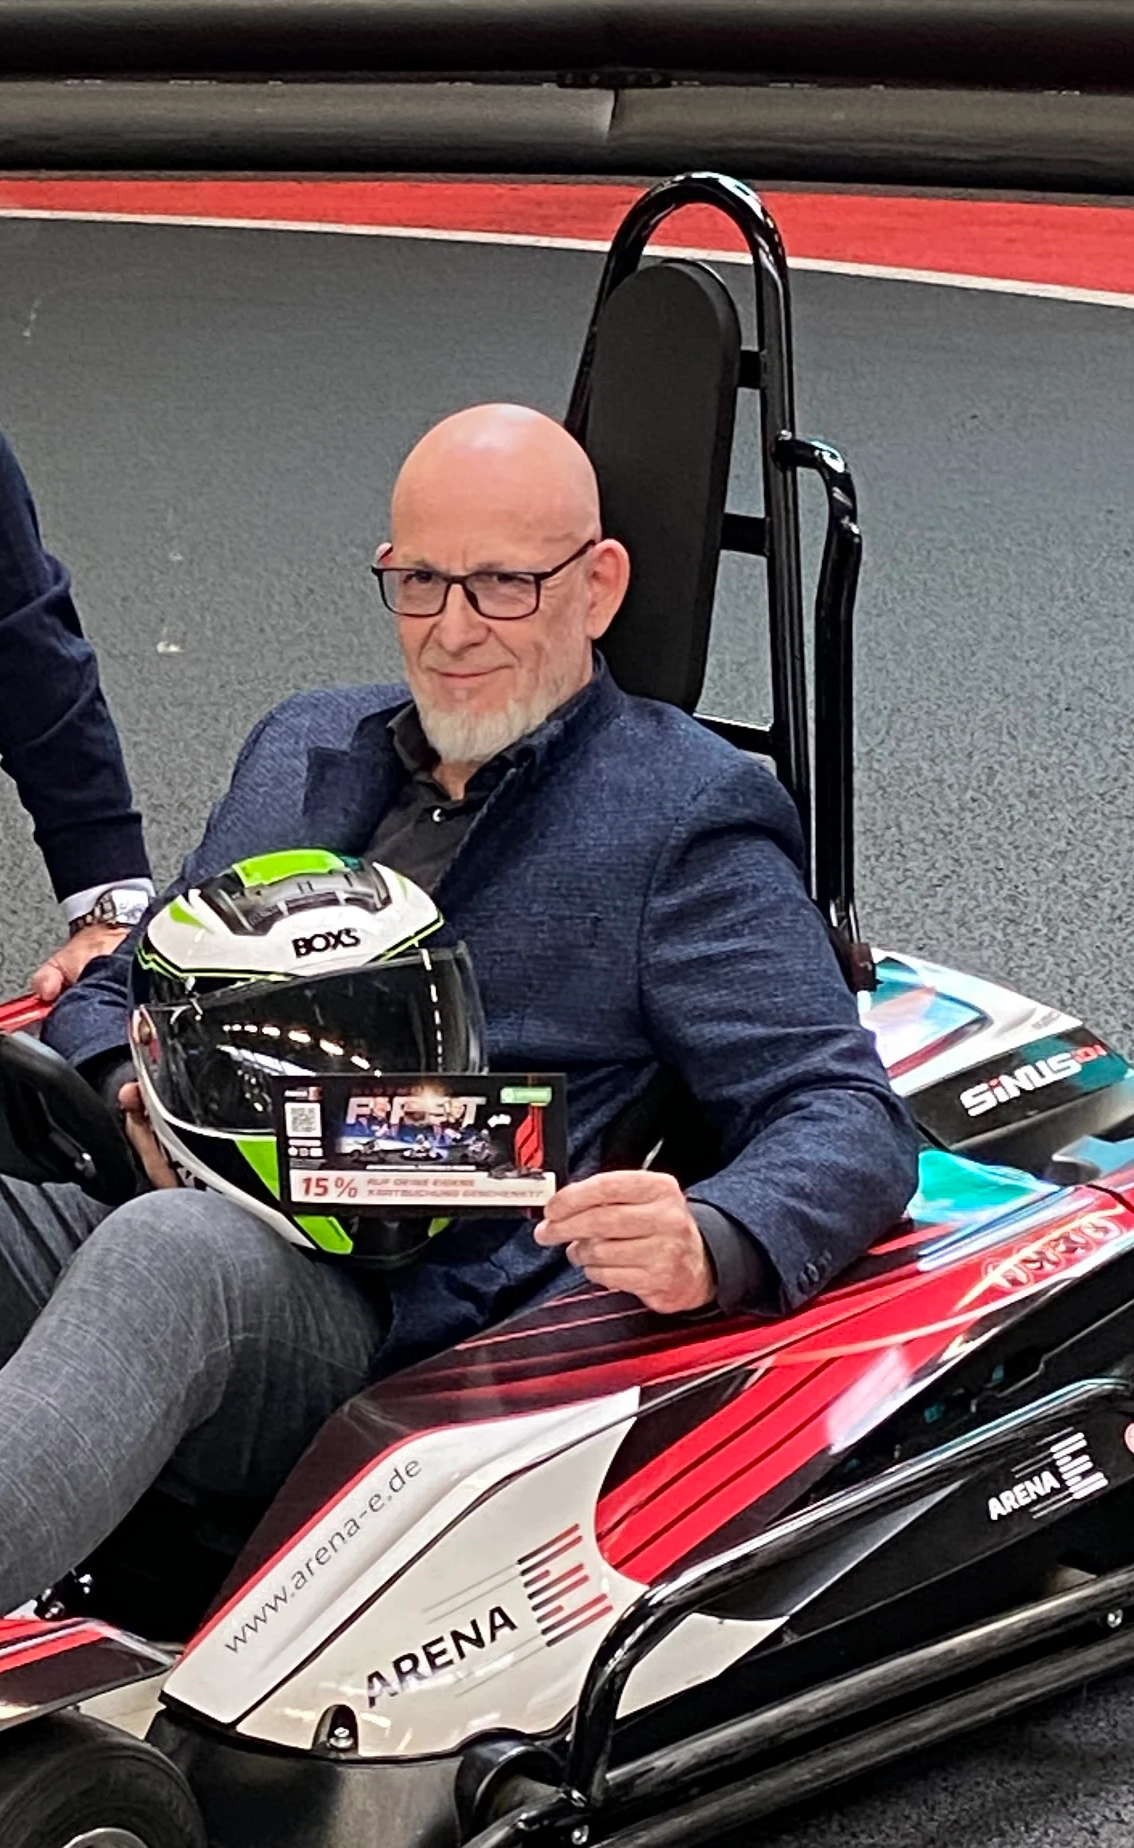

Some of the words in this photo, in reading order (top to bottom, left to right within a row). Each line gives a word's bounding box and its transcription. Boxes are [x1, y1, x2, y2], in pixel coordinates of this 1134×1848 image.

[291, 928, 361, 959] BOXS
[303, 1177, 329, 1197] 15
[334, 1176, 358, 1198] %
[987, 1470, 1061, 1520] ARENA
[224, 1457, 423, 1654] www.arena-e.de
[366, 1604, 519, 1708] ARENA
